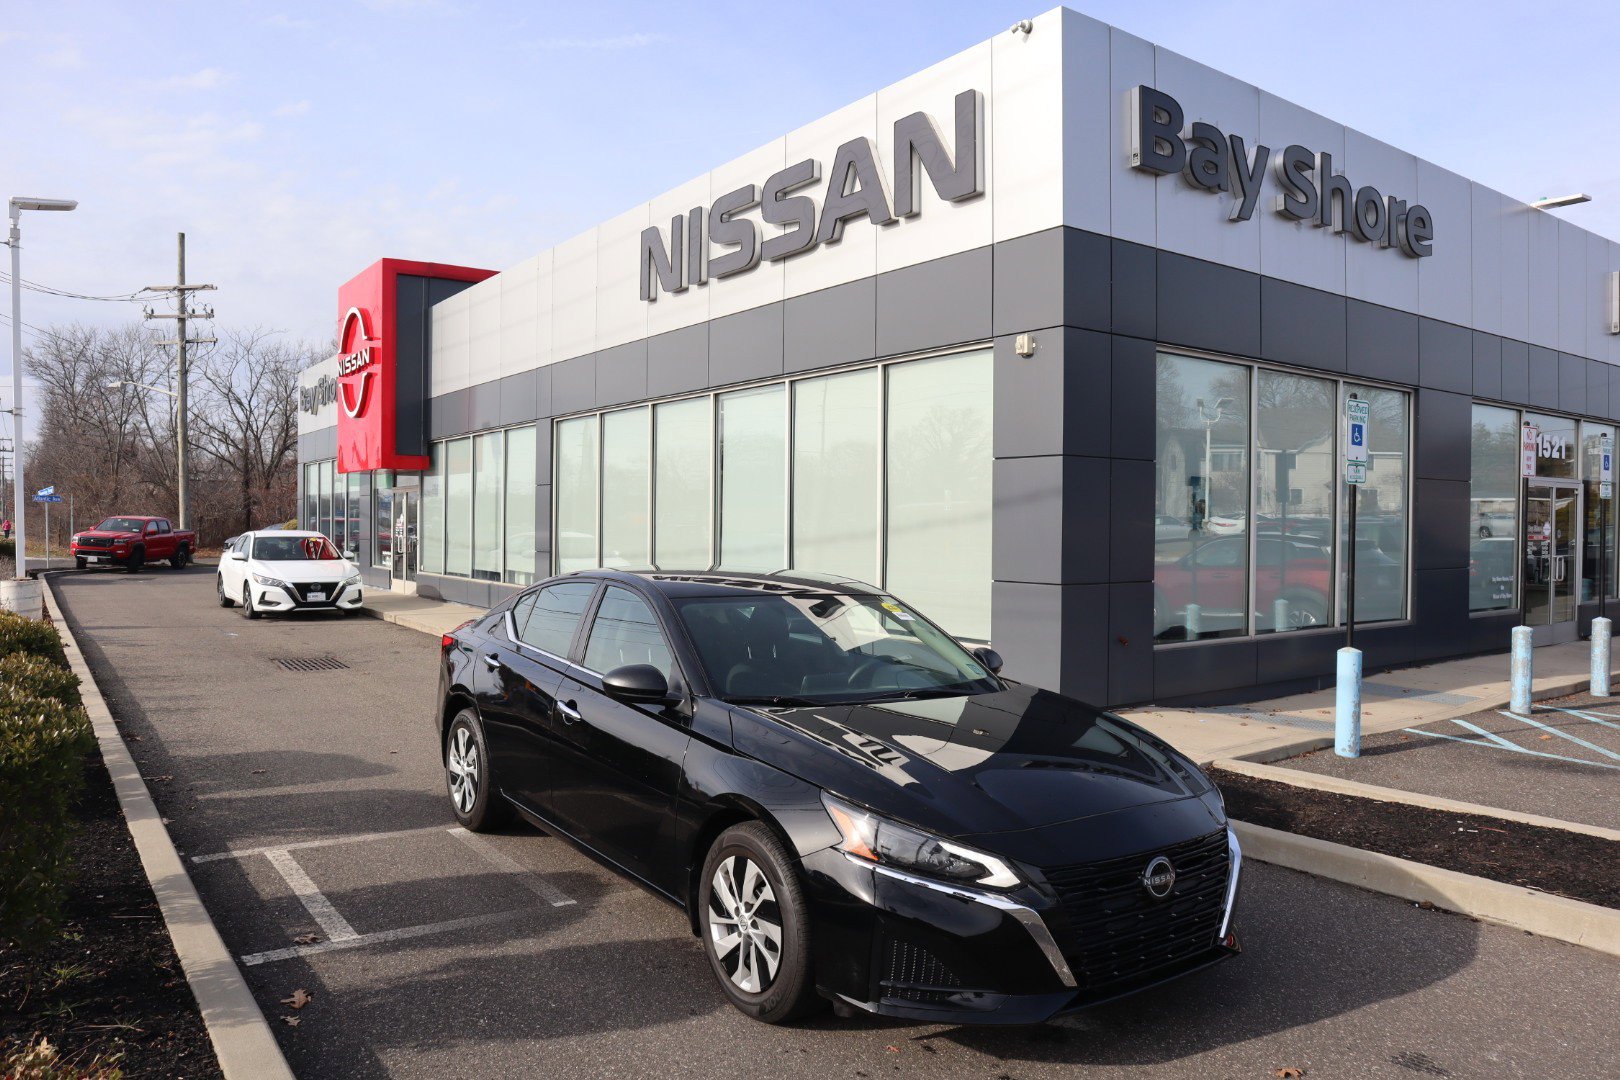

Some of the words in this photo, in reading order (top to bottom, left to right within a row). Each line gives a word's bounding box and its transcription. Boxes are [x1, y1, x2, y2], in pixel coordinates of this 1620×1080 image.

[1133, 85, 1269, 222] Bay
[1275, 144, 1433, 258] Shore
[640, 88, 983, 302] NISSAN
[338, 346, 369, 377] NISSAN
[300, 385, 318, 415] Bay
[318, 374, 337, 406] Sho
[1536, 433, 1566, 460] 1521
[1144, 872, 1175, 886] NISSAN
